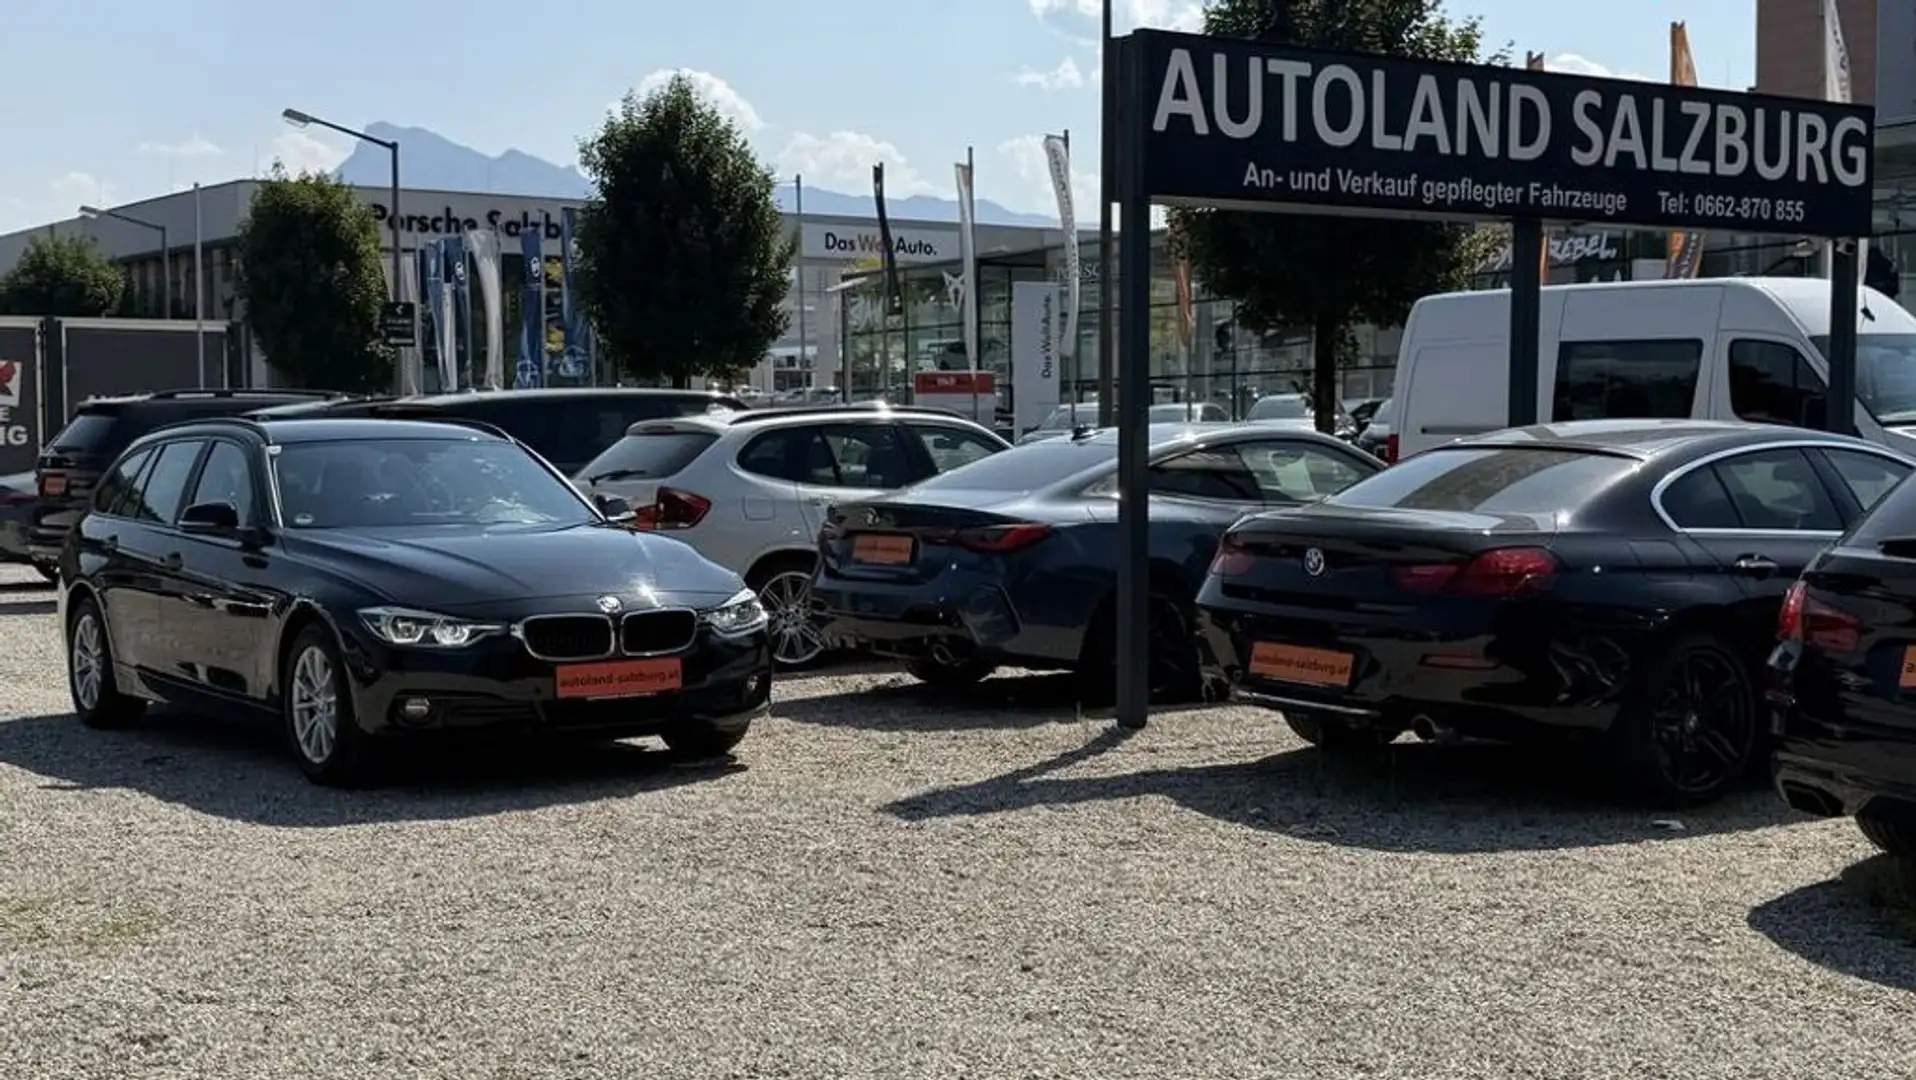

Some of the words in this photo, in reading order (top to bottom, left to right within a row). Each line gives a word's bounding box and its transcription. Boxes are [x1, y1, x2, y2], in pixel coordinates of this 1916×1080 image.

[1152, 48, 1551, 160] AUTOLAND
[1571, 90, 1868, 187] SALZBURG
[1243, 161, 1284, 188] An-
[1290, 168, 1331, 192] und
[1336, 168, 1418, 197] Verkauf
[1422, 177, 1524, 208] gepflegter
[1529, 181, 1628, 215] Fahrzeuge
[1657, 190, 1689, 214] Tel:
[1694, 193, 1771, 219] 0662-870
[1775, 200, 1805, 221] 855
[825, 231, 856, 251] Das
